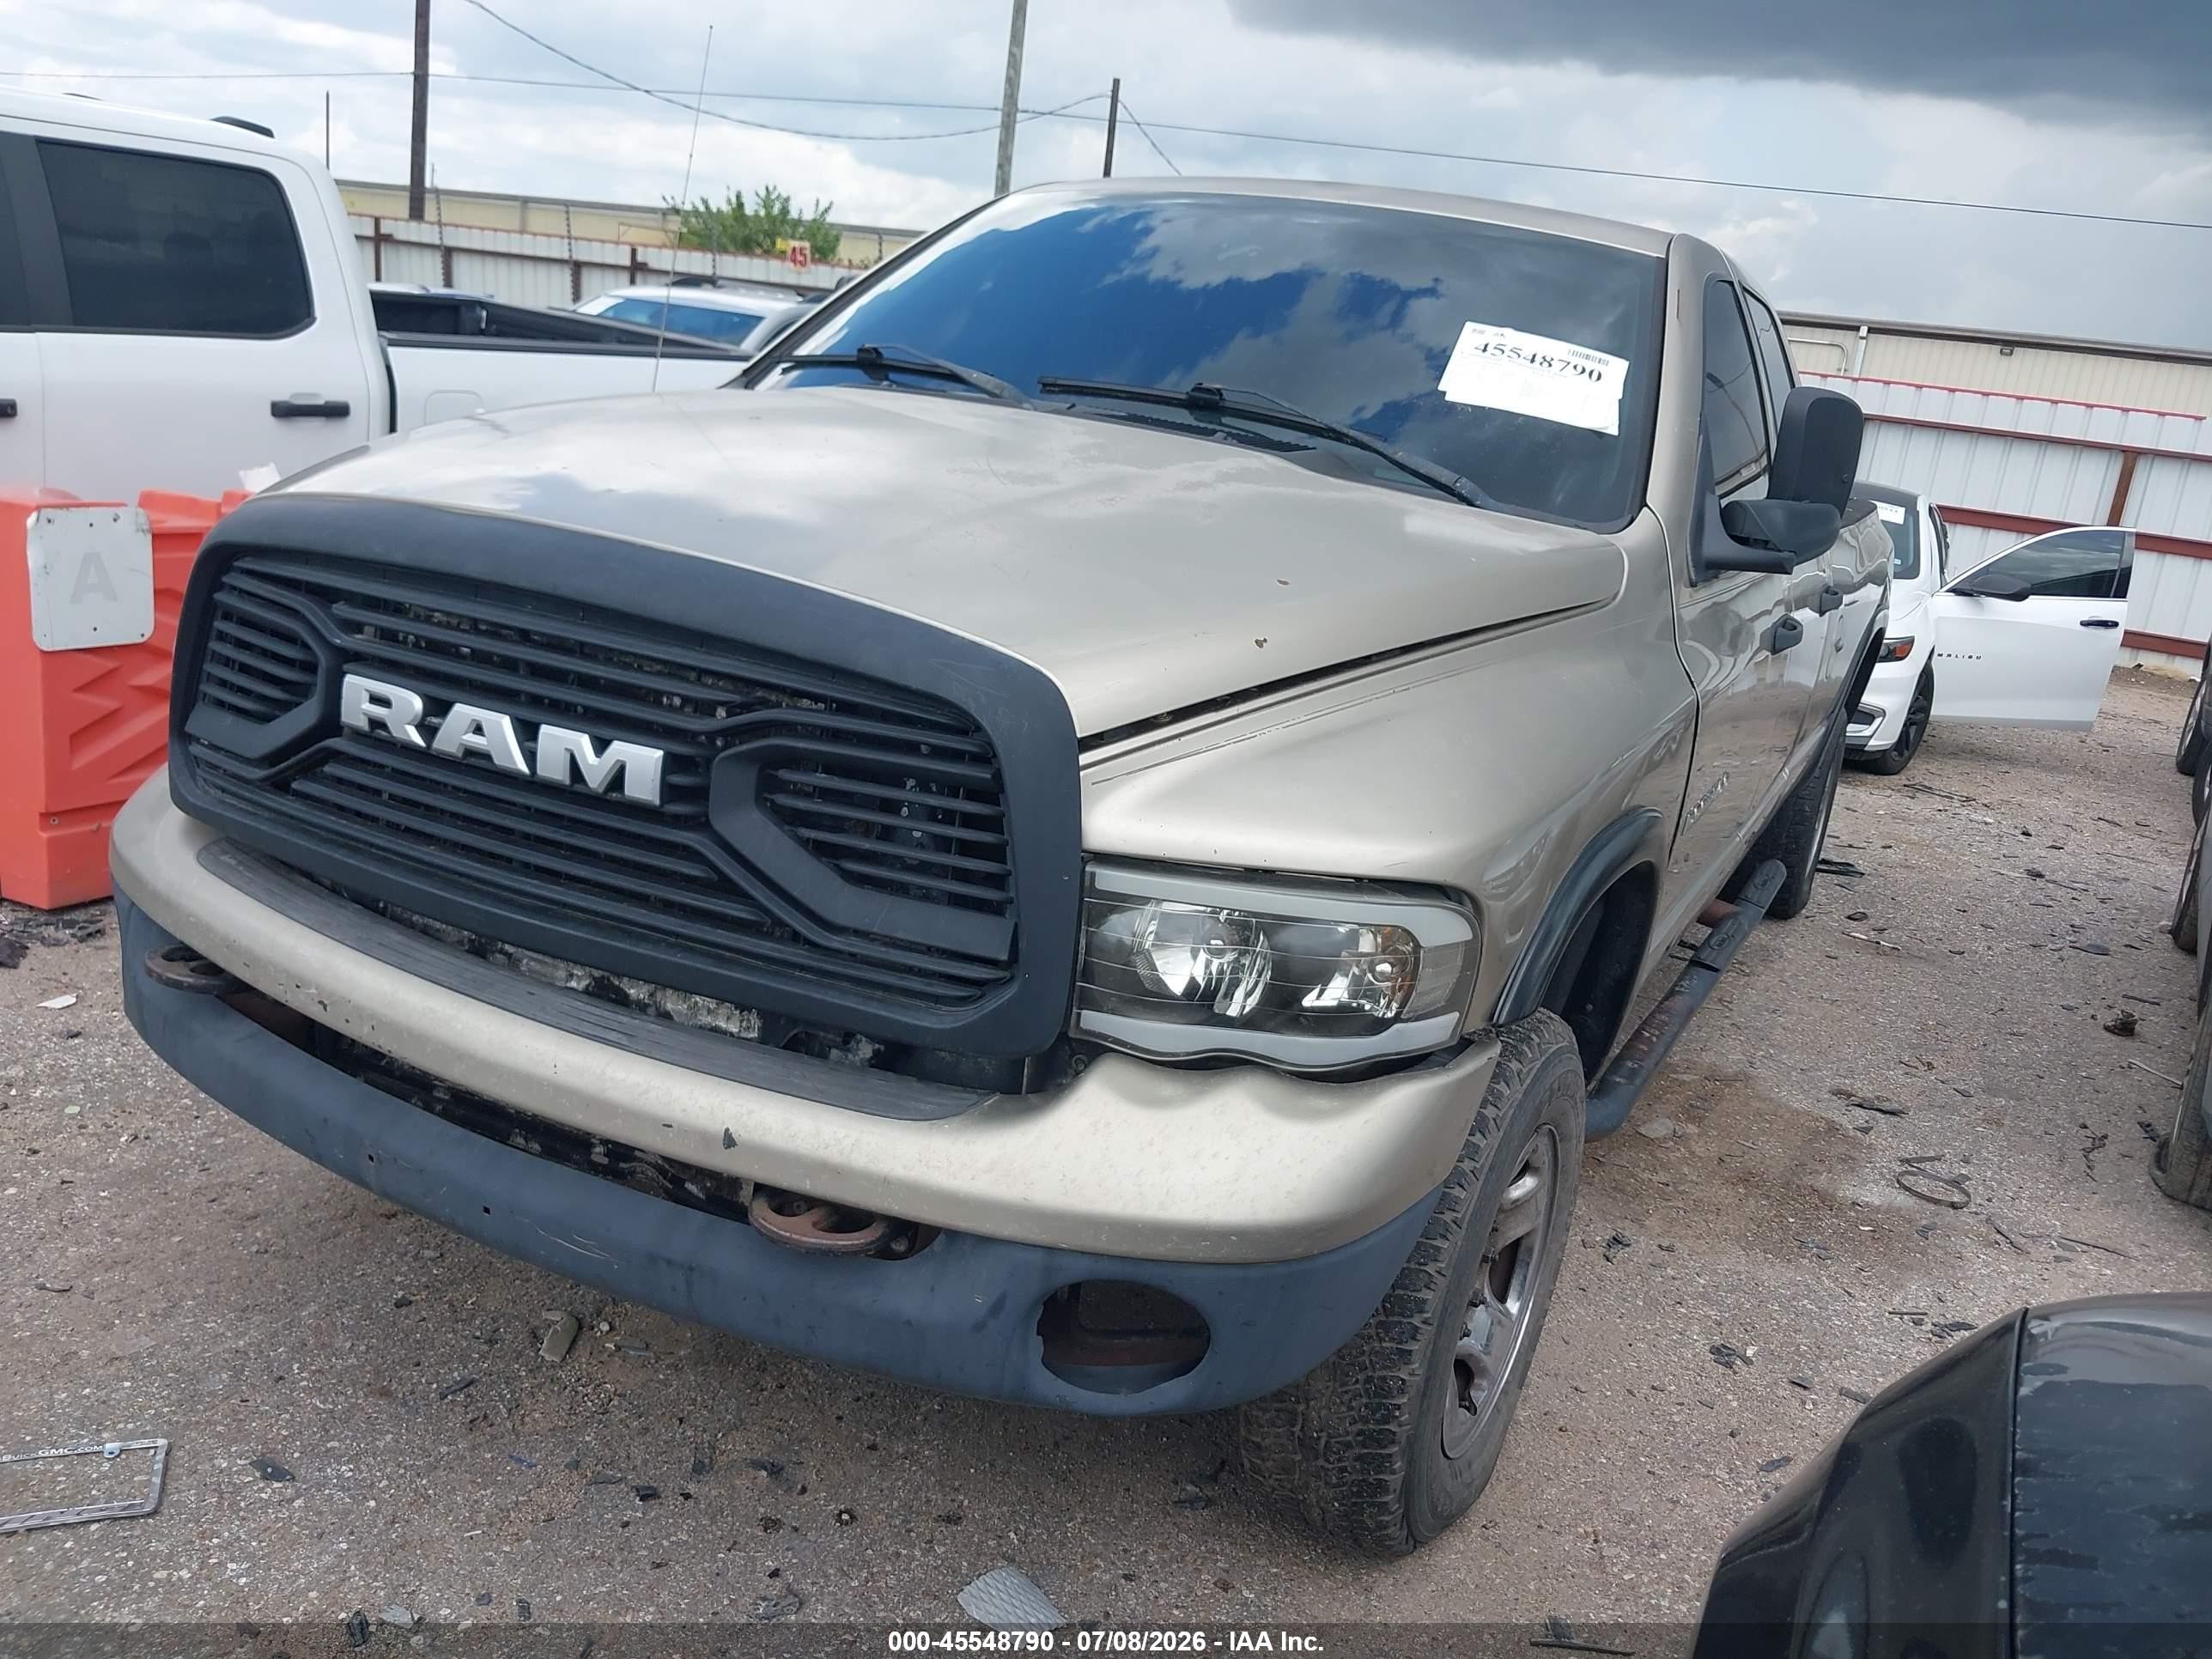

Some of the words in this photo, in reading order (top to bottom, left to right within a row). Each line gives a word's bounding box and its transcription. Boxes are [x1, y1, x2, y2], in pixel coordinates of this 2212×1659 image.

[790, 246, 807, 268] 45
[1474, 342, 1602, 382] 45548790
[70, 551, 118, 605] A
[340, 672, 665, 808] RAM
